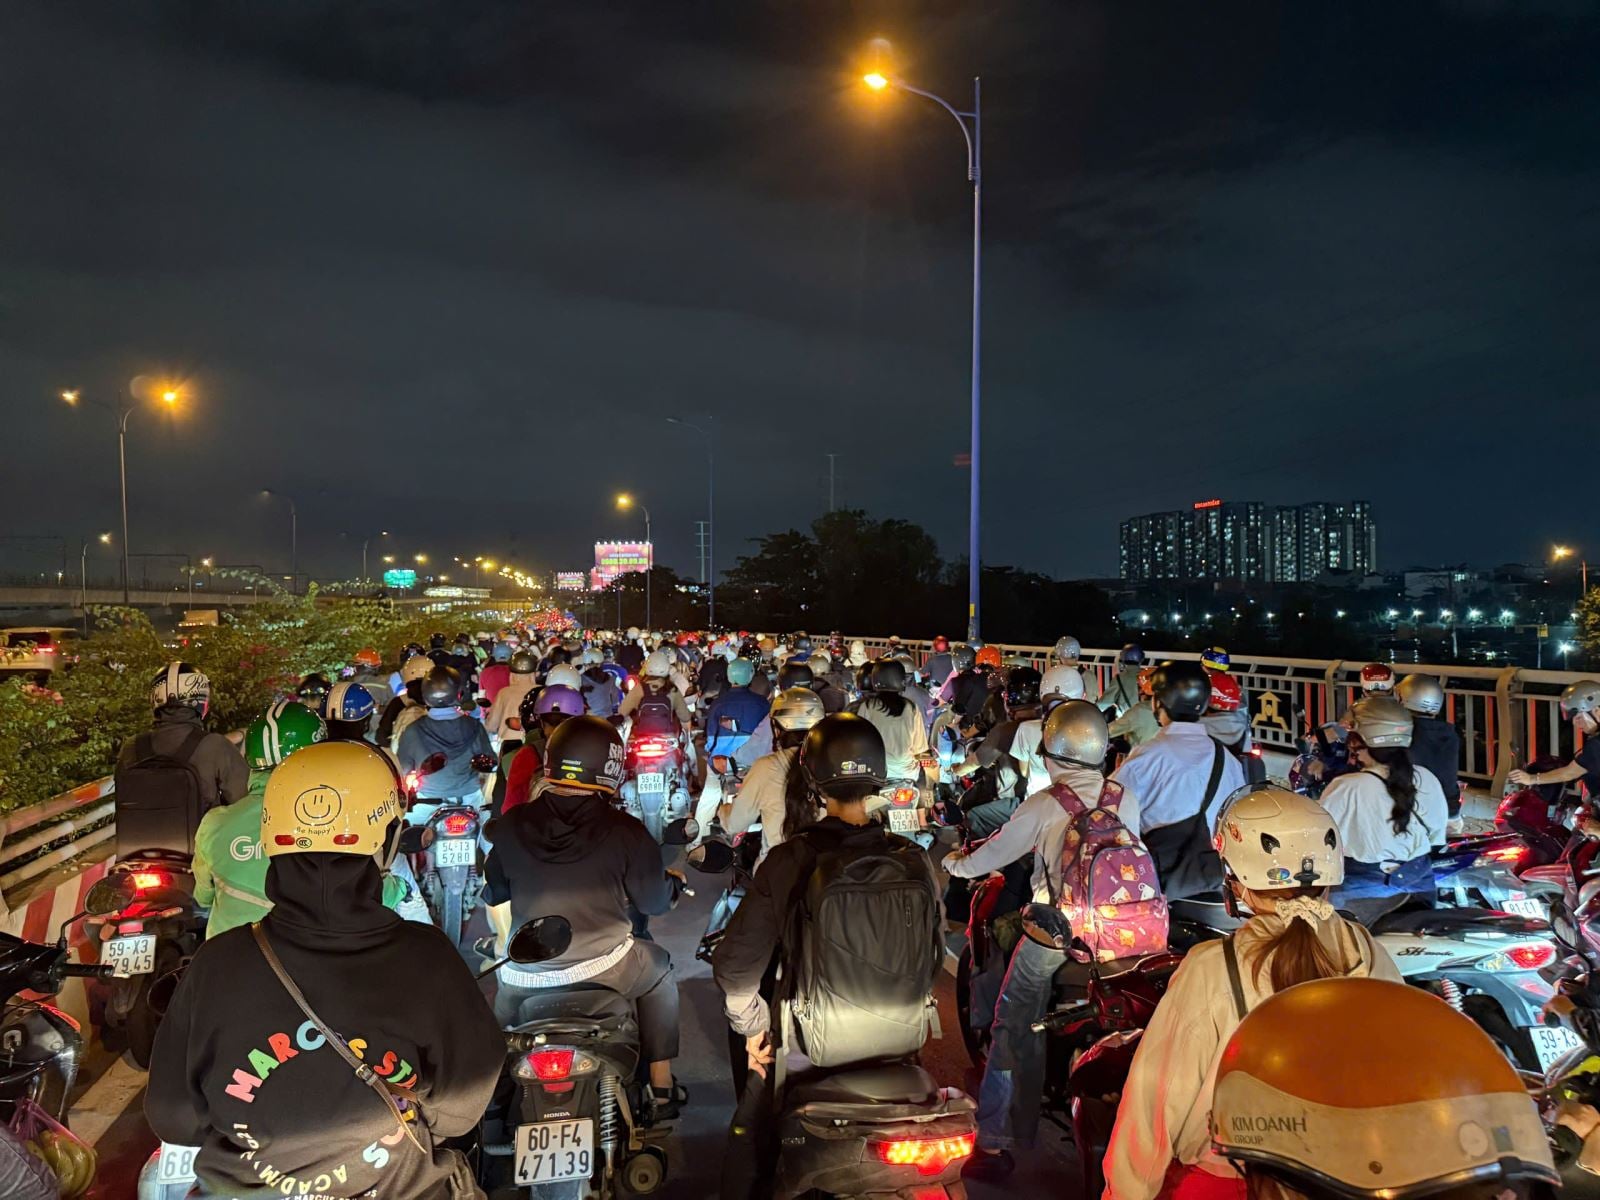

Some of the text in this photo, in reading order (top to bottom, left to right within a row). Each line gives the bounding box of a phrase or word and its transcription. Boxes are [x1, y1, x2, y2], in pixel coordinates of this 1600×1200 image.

[109, 939, 149, 957] 59-X3
[225, 1020, 367, 1103] MARCS
[543, 1111, 571, 1119] HONDA
[528, 1123, 582, 1152] 60-F4
[1234, 1134, 1264, 1145] GROUP
[164, 1150, 193, 1177] 68
[518, 1150, 589, 1180] 471.39
